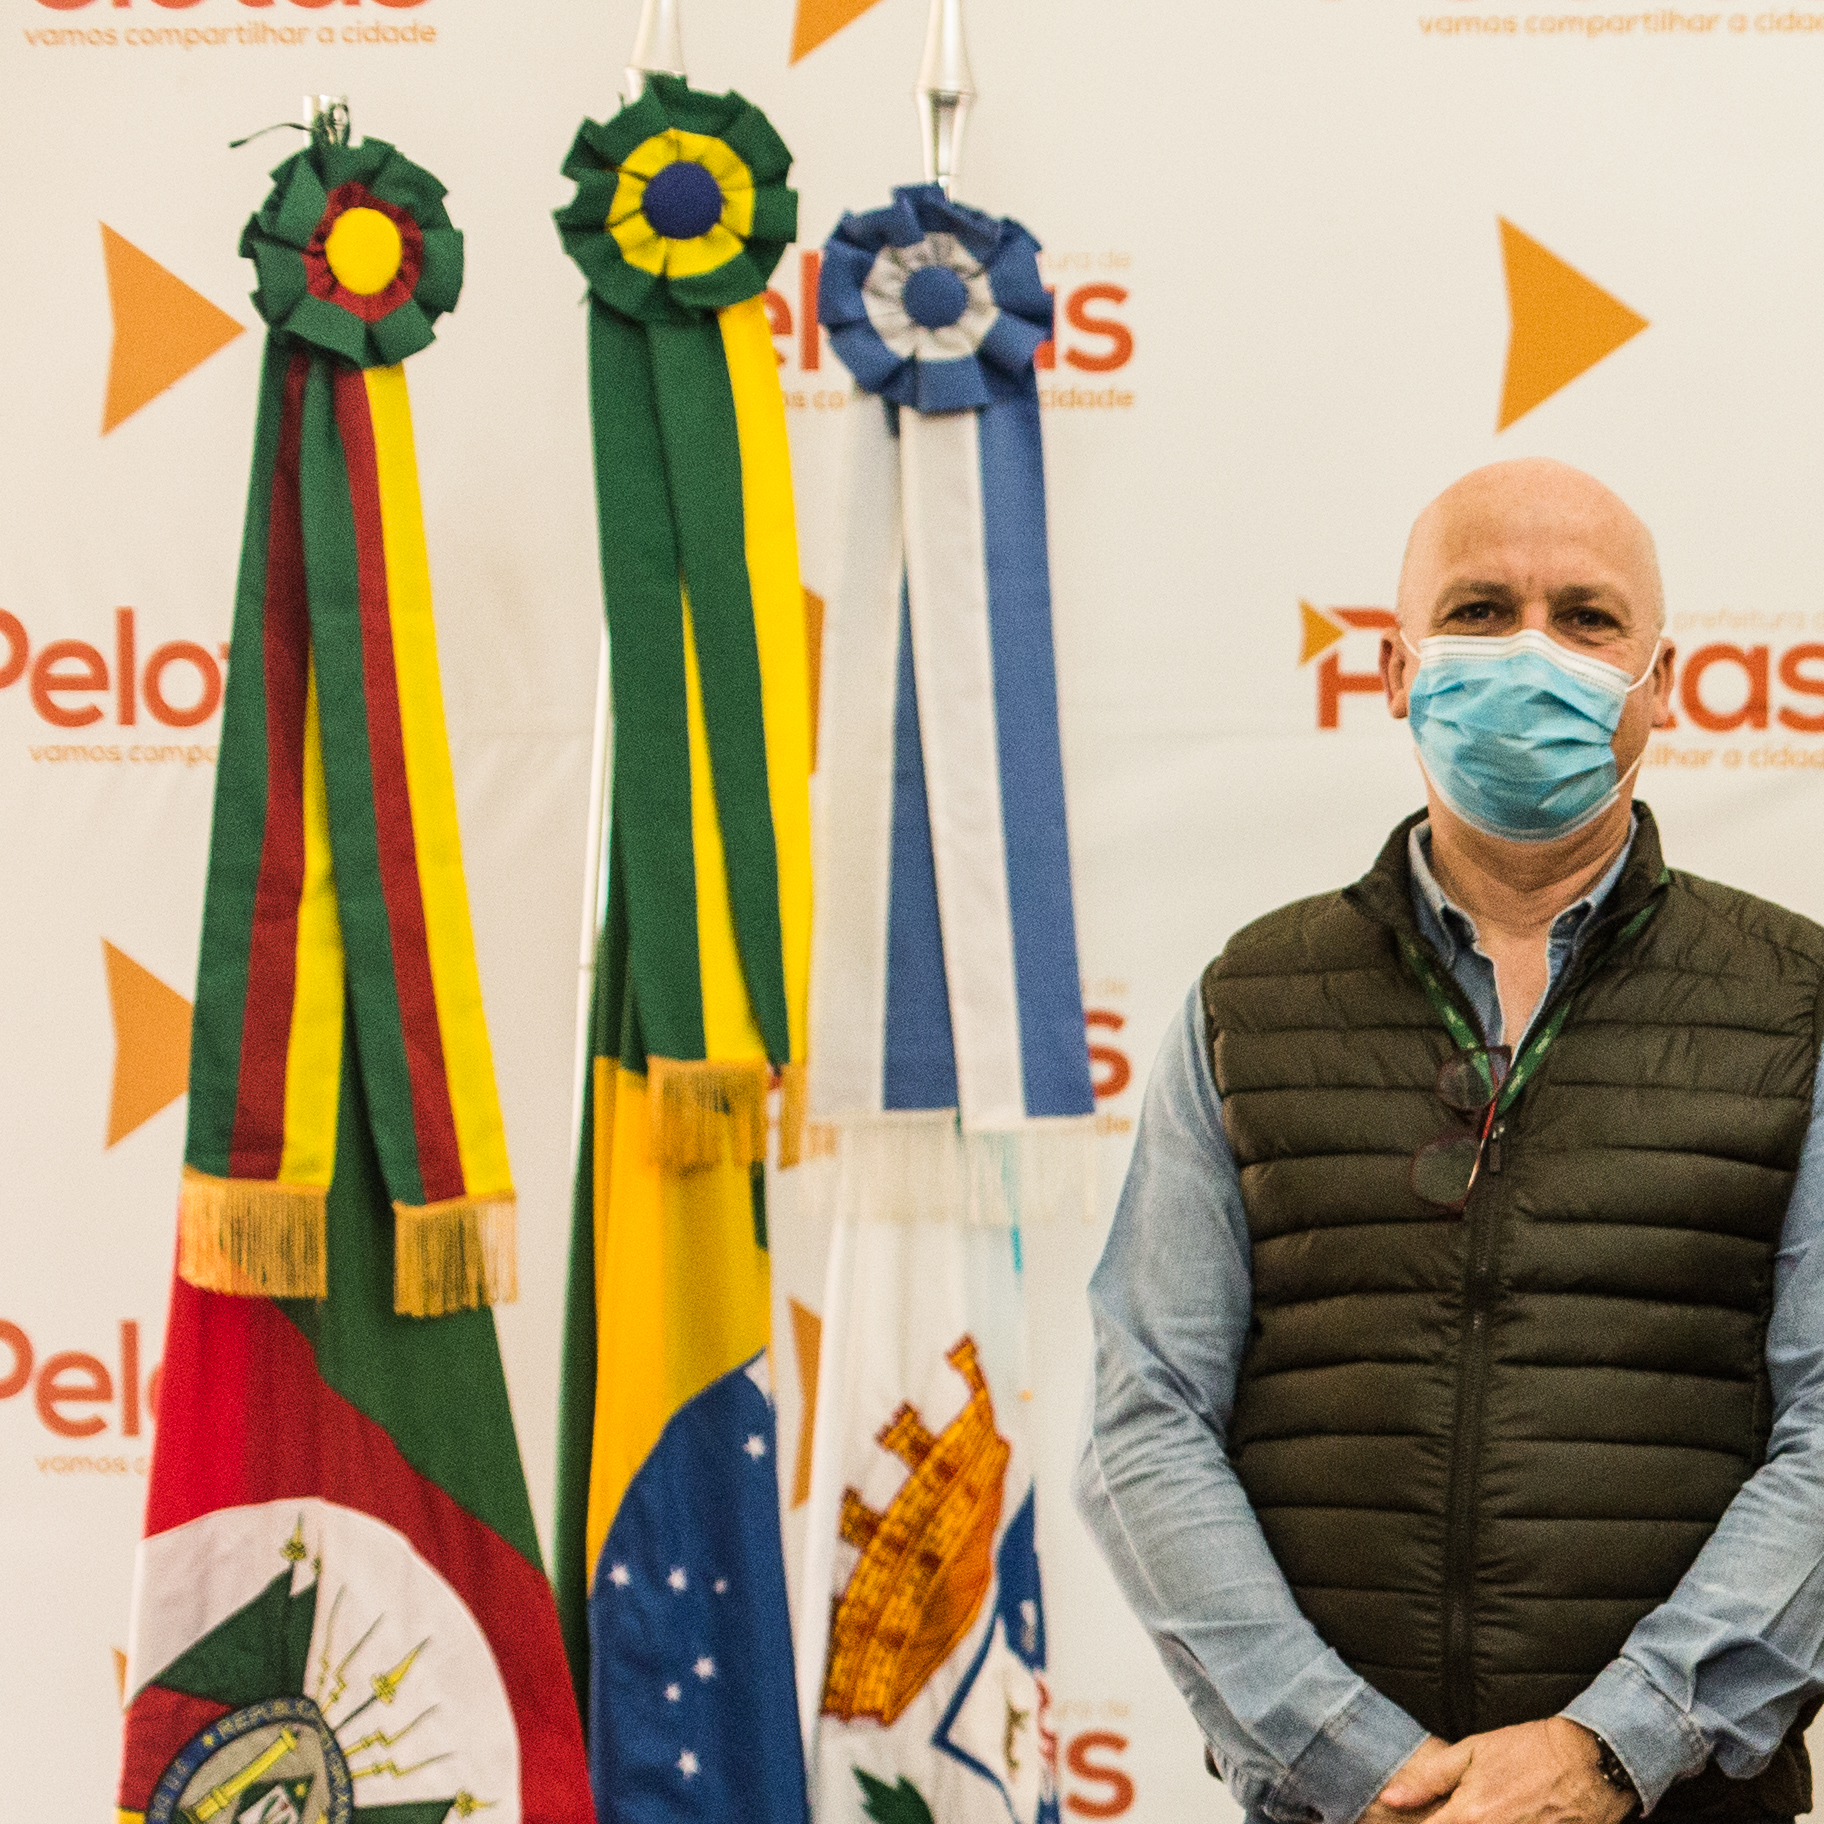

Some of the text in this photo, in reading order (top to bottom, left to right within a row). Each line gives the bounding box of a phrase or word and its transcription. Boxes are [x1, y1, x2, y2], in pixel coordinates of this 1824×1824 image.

[22, 19, 437, 51] vamos compartilhar a cidade
[1419, 15, 1517, 34] vamos
[1525, 10, 1721, 38] compartilhar
[1728, 14, 1747, 32] a
[28, 745, 122, 762] vamos
